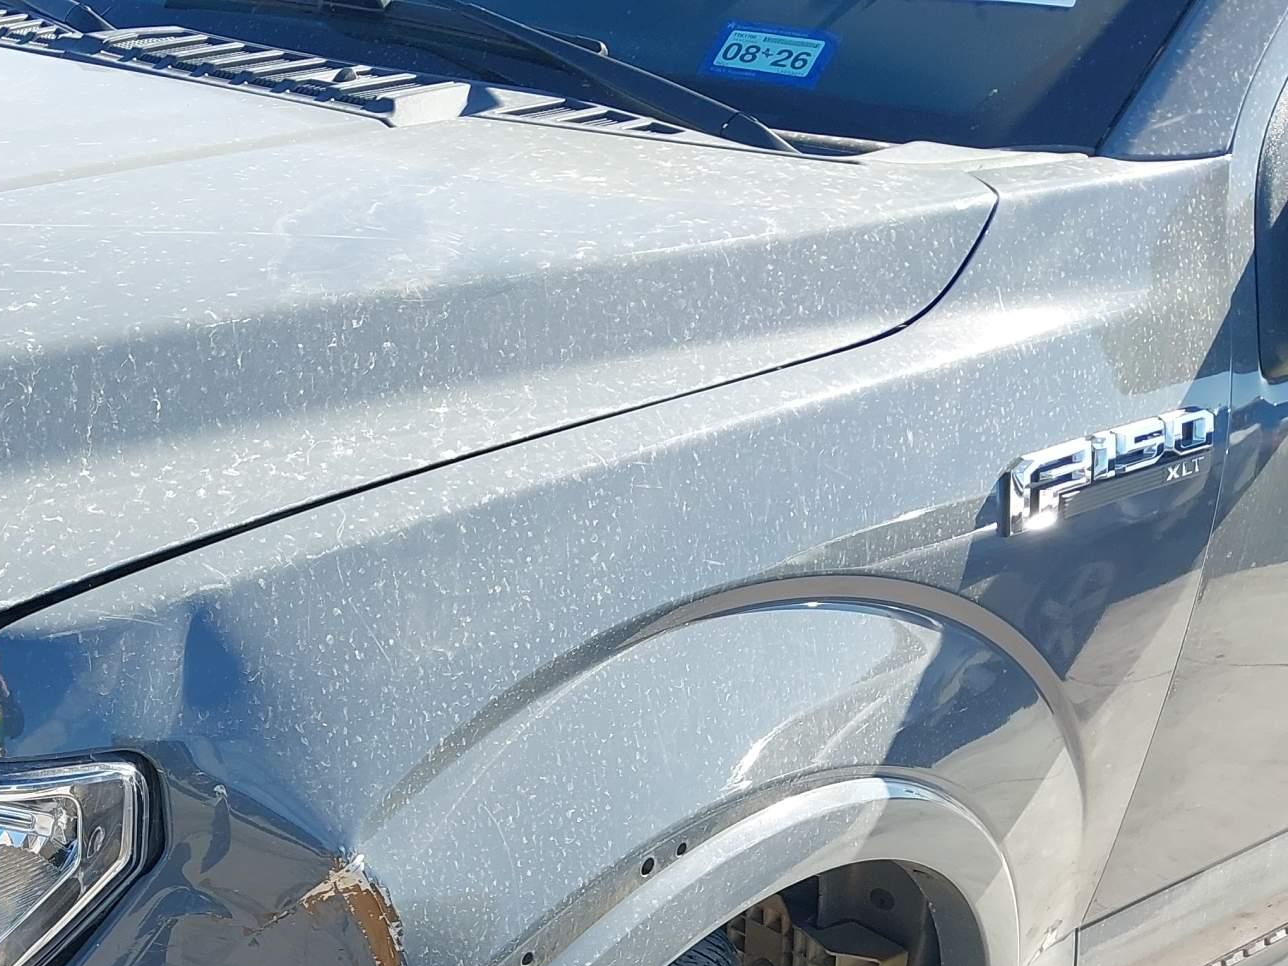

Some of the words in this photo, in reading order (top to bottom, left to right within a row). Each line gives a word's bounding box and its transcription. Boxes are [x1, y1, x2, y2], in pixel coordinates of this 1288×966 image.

[722, 42, 761, 63] 08
[770, 49, 812, 70] 26
[1167, 456, 1205, 482] XLT
